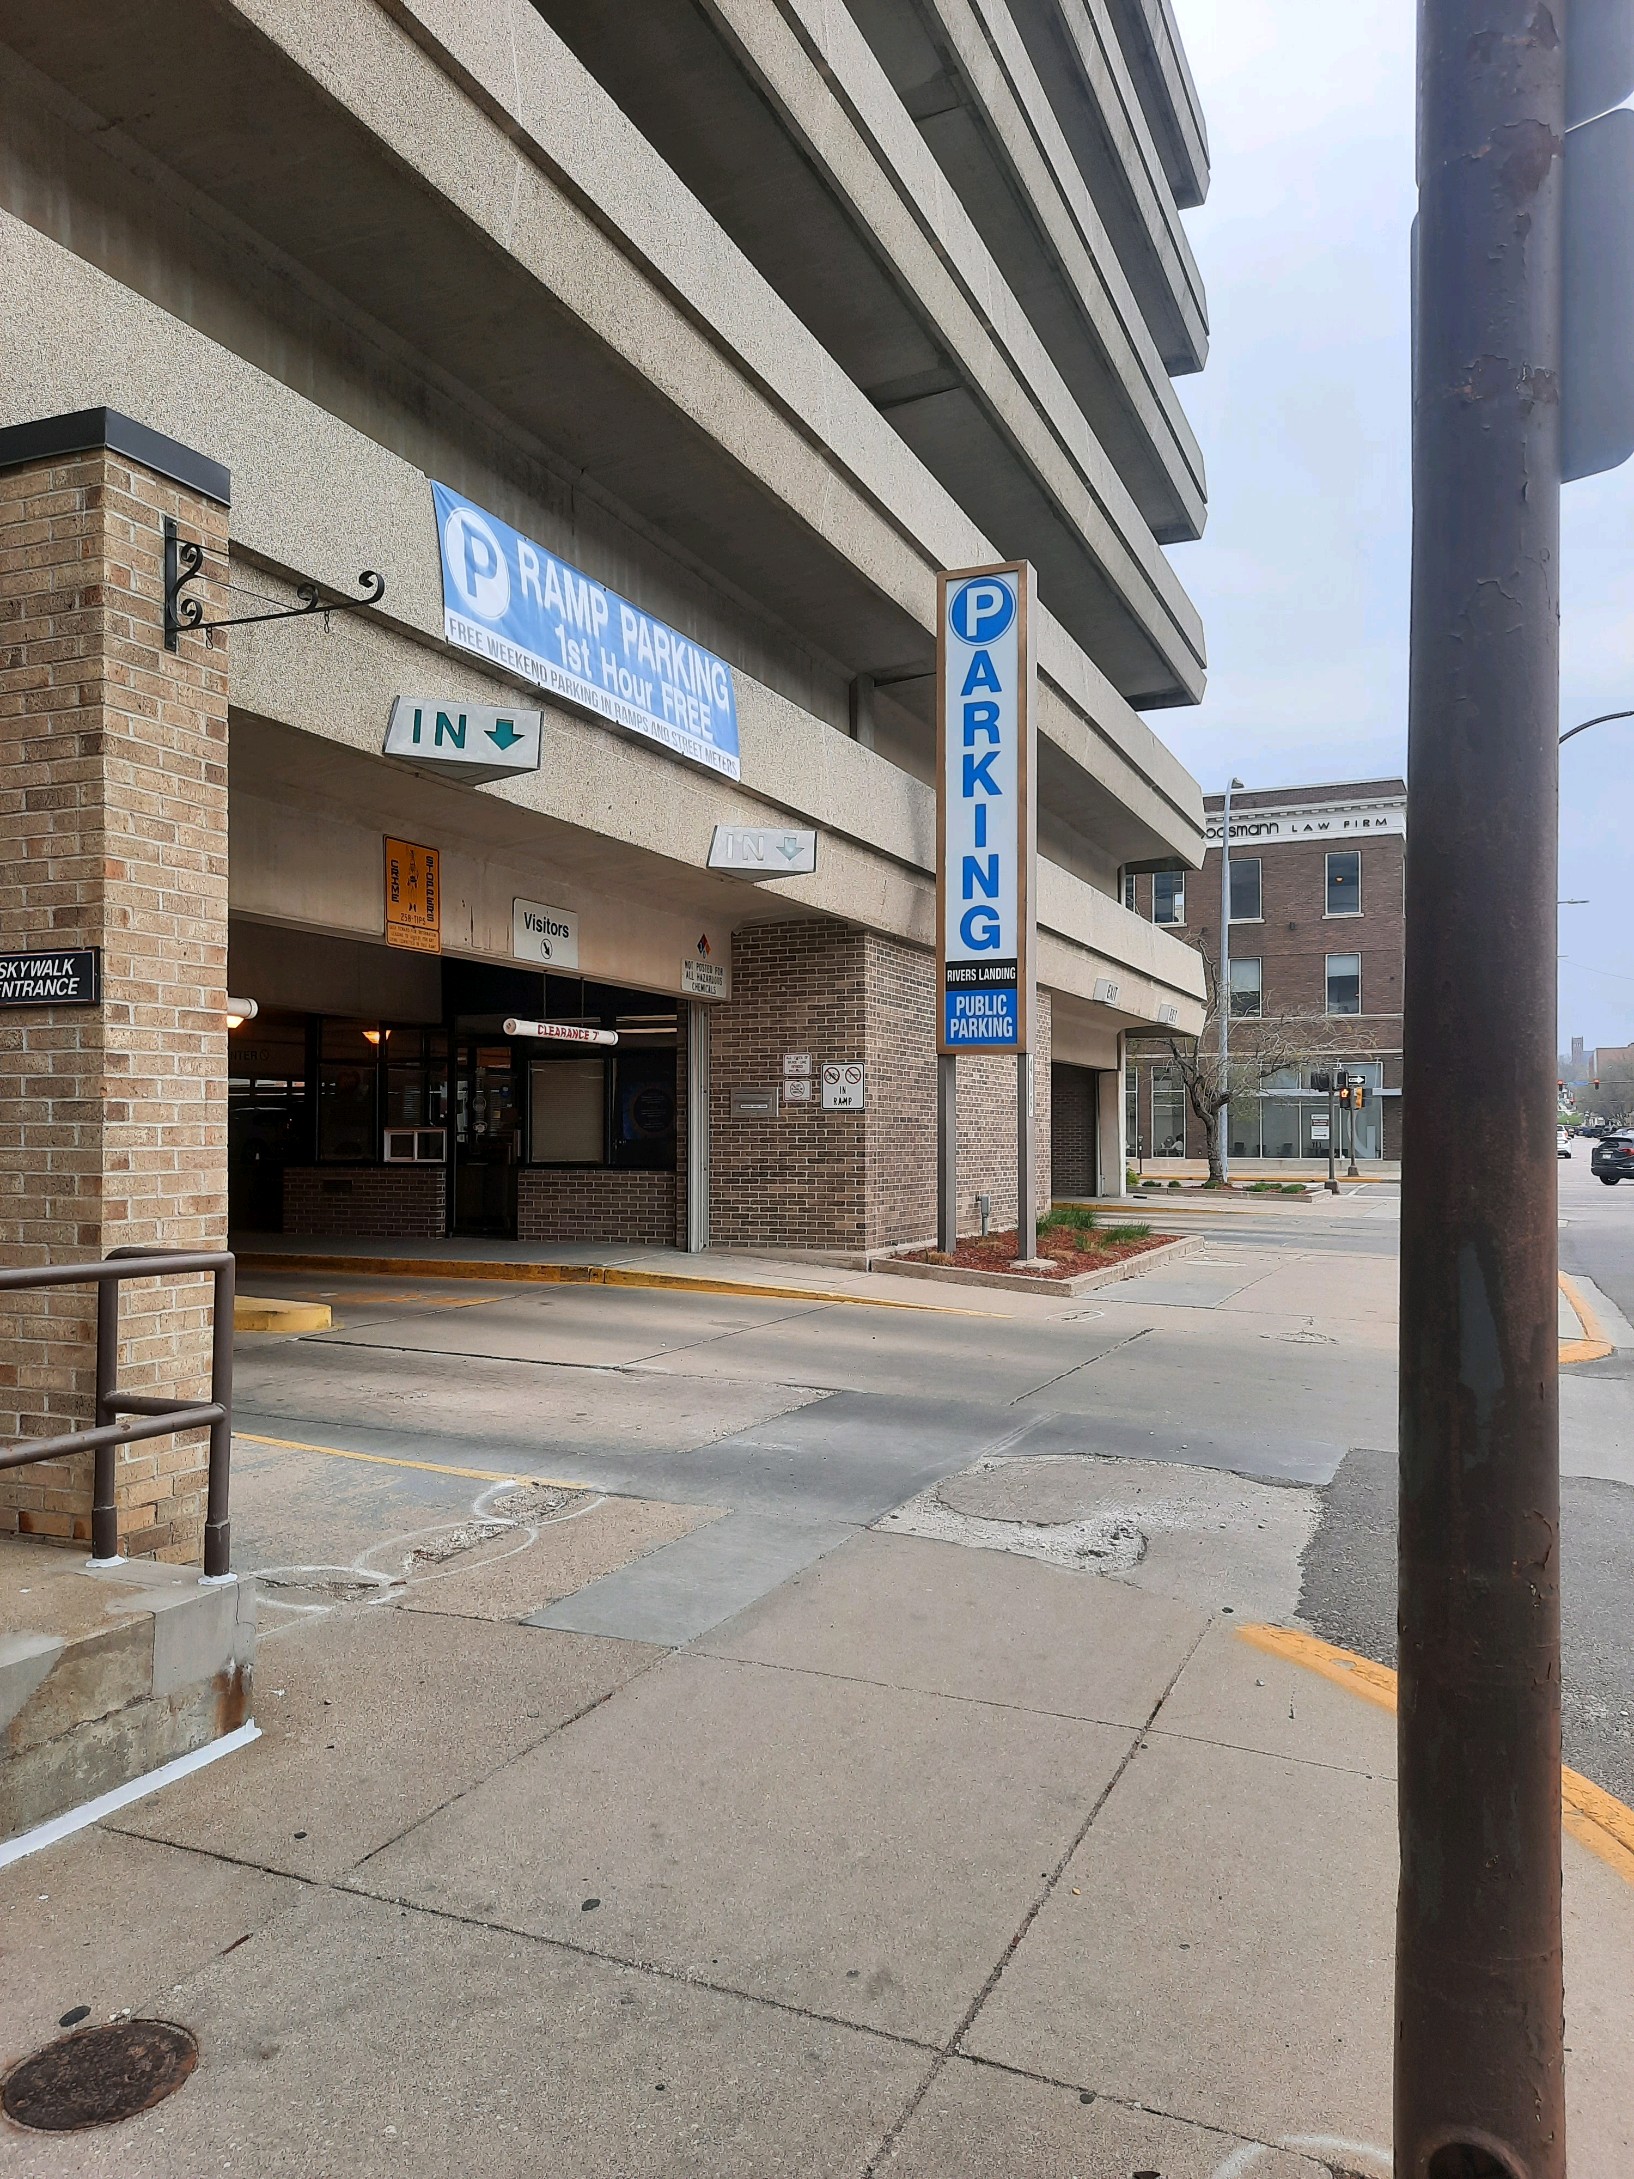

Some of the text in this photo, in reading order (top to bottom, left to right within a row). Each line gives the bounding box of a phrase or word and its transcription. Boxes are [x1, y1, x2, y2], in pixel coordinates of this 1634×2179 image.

[460, 518, 498, 599] P
[517, 539, 731, 708] RAMP PARKING
[555, 624, 715, 741] 1st Hour FREE
[449, 617, 738, 776] FREE WEEKEND PARKING IN RAMPS AND STREET METERS
[412, 708, 468, 749] IN
[959, 585, 1004, 951] PARKING
[1206, 818, 1388, 839] oosmann LAW FIRM
[725, 832, 766, 863] IN
[390, 859, 400, 903] CRIME
[425, 856, 435, 923] STOPPERS
[523, 911, 570, 939] Visitors
[0, 957, 75, 979] SKYWALK
[684, 960, 724, 976] NOT POSTED FOR
[686, 970, 723, 986] ALL HAZARDOUS
[946, 965, 1017, 983] RIVERS LANDING
[691, 982, 717, 995] CHEMICALS
[1106, 984, 1119, 1002] EXIT
[955, 994, 1008, 1018] PUBLIC
[537, 1024, 590, 1040] CLEARANCE
[950, 1016, 1014, 1040] PARKING
[229, 1050, 258, 1061] NTER
[833, 1096, 853, 1106] RAMP
[839, 1085, 847, 1095] IN
